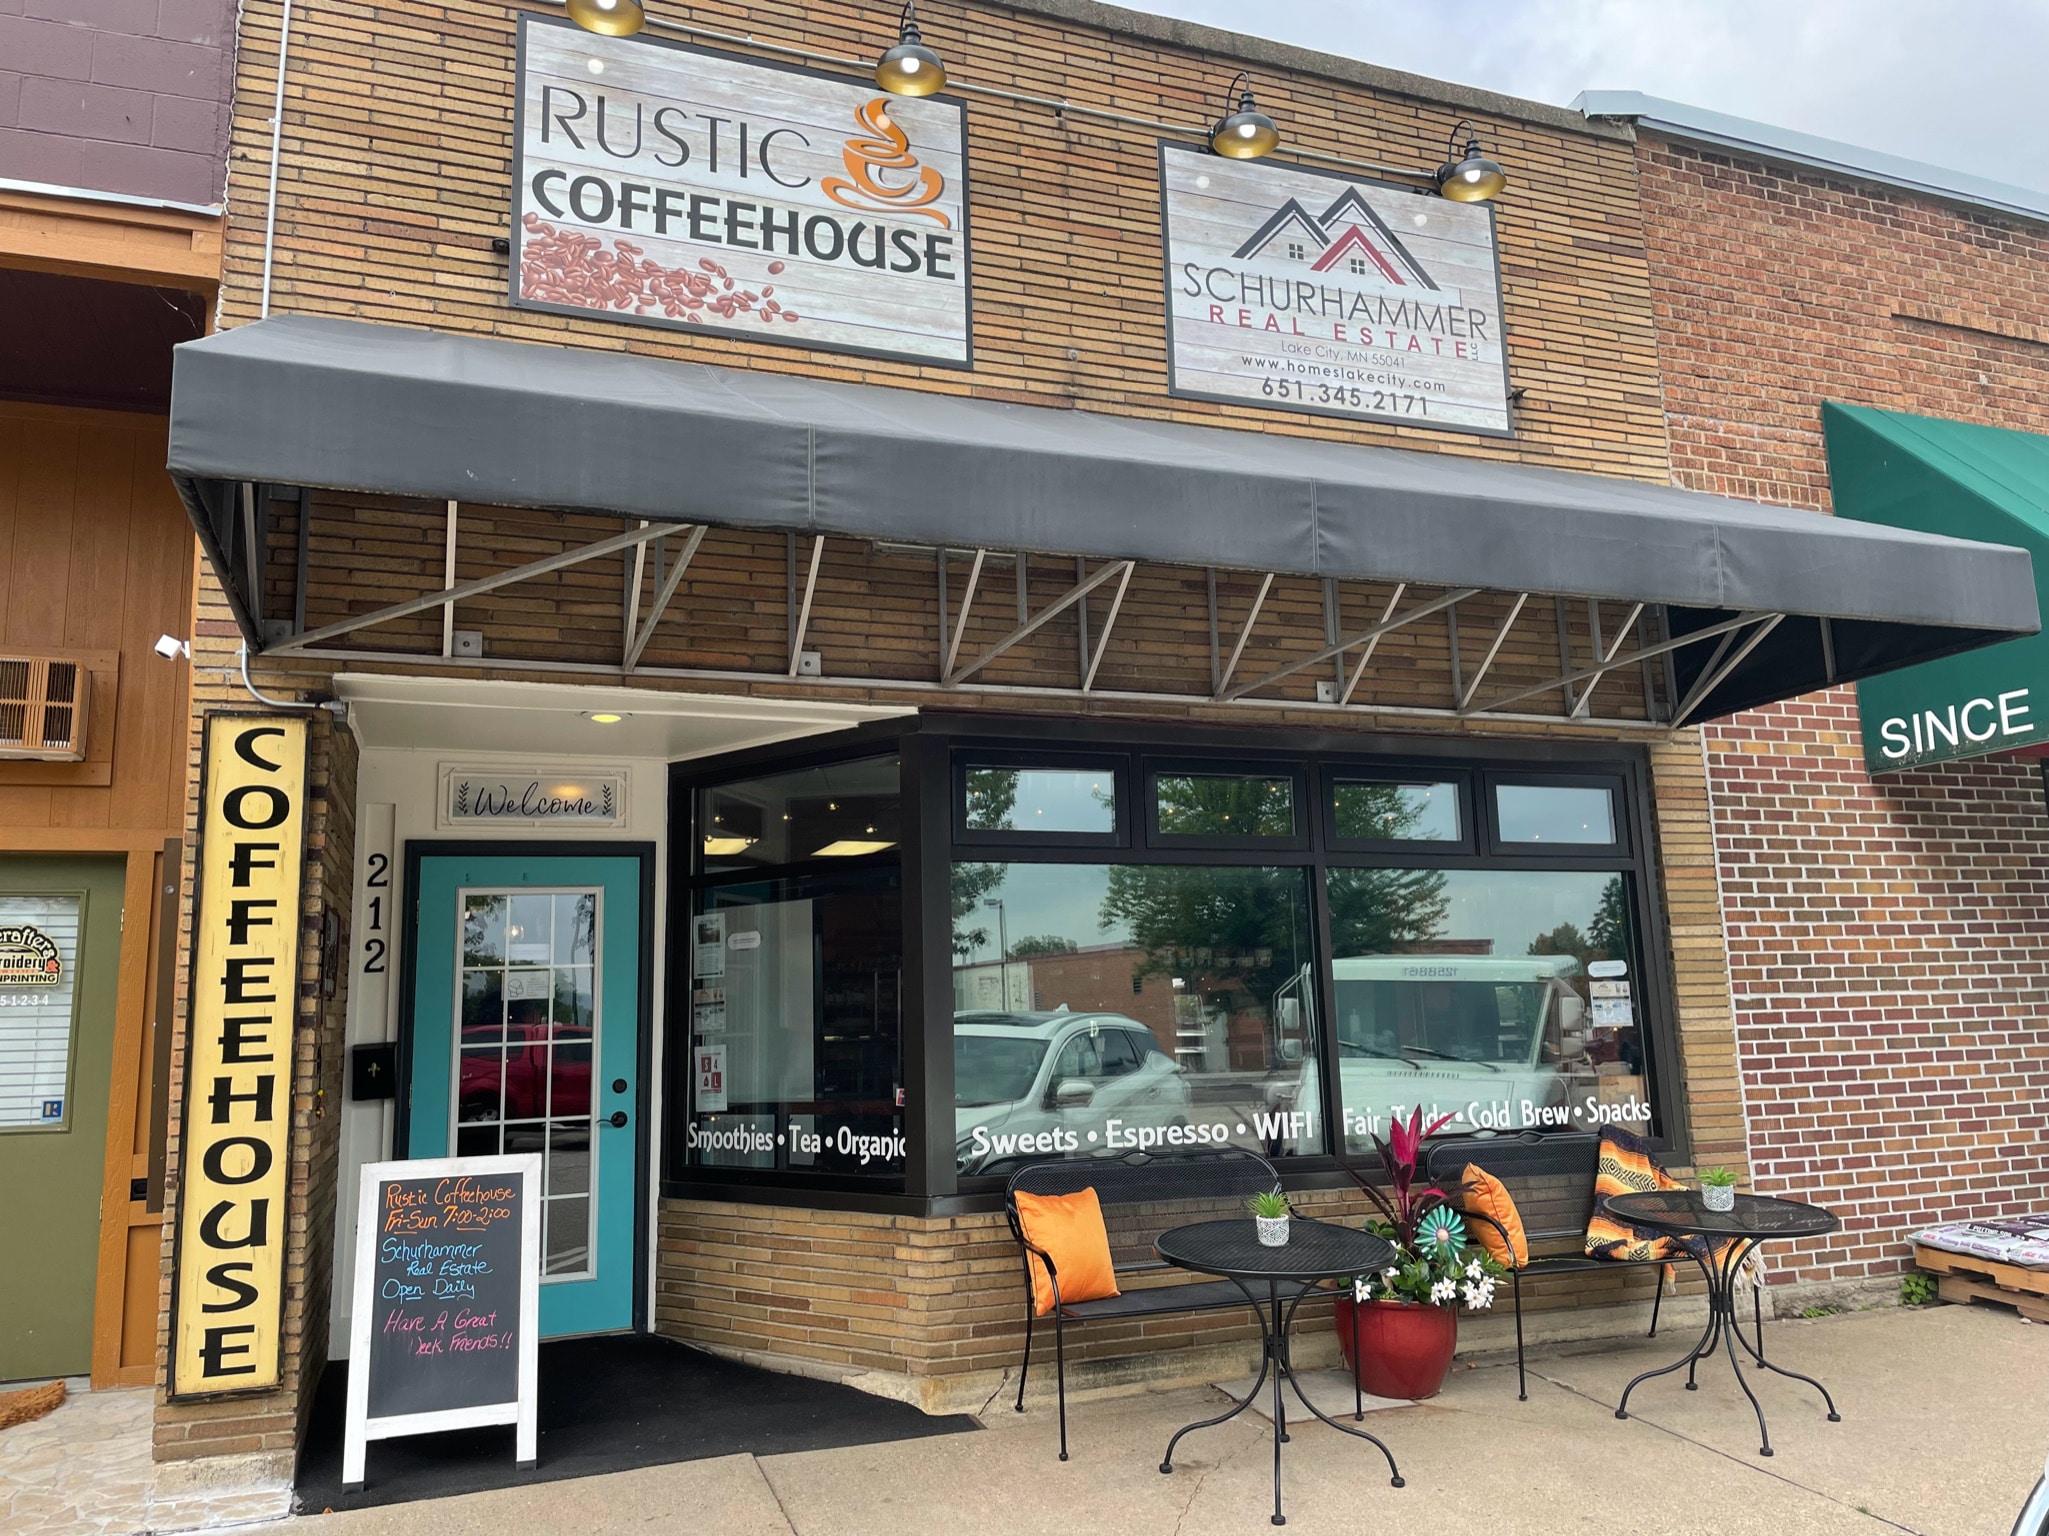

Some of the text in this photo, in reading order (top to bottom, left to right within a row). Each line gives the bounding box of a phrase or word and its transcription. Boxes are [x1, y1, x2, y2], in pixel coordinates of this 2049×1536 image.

[541, 84, 811, 188] RUSTIC
[531, 169, 956, 281] COFFEEHOUSE
[1183, 262, 1488, 341] SCHURHAMMER
[1209, 304, 1468, 359] REAL ESTATE
[1281, 340, 1406, 368] Lake City, MN 55041
[1470, 342, 1479, 361] LLC
[1242, 355, 1446, 392] www.homeslakecity.com
[1261, 376, 1428, 415] 651.345.2171
[1880, 688, 2034, 758] SINCE
[474, 781, 598, 816] Welcome
[199, 727, 291, 1378] COFFEEHOUSE
[971, 1111, 1314, 1156] Sweets Espresso WIFI
[1342, 1107, 1381, 1136] Fair
[1468, 1099, 1511, 1128] Cold
[1521, 1099, 1570, 1126] Brew
[1586, 1095, 1651, 1125] Snacks
[687, 1122, 906, 1165] Smoothies Tea Organic
[386, 1177, 516, 1208] Rustic Coffeehouse
[384, 1205, 511, 1232] Fri-Sun 7:00-2:00
[381, 1237, 483, 1263] Schurhammer
[406, 1260, 493, 1277] Real Estate
[382, 1278, 475, 1304] Open Daily
[383, 1308, 497, 1333] Have A Great
[449, 1330, 513, 1352] Friends!!
